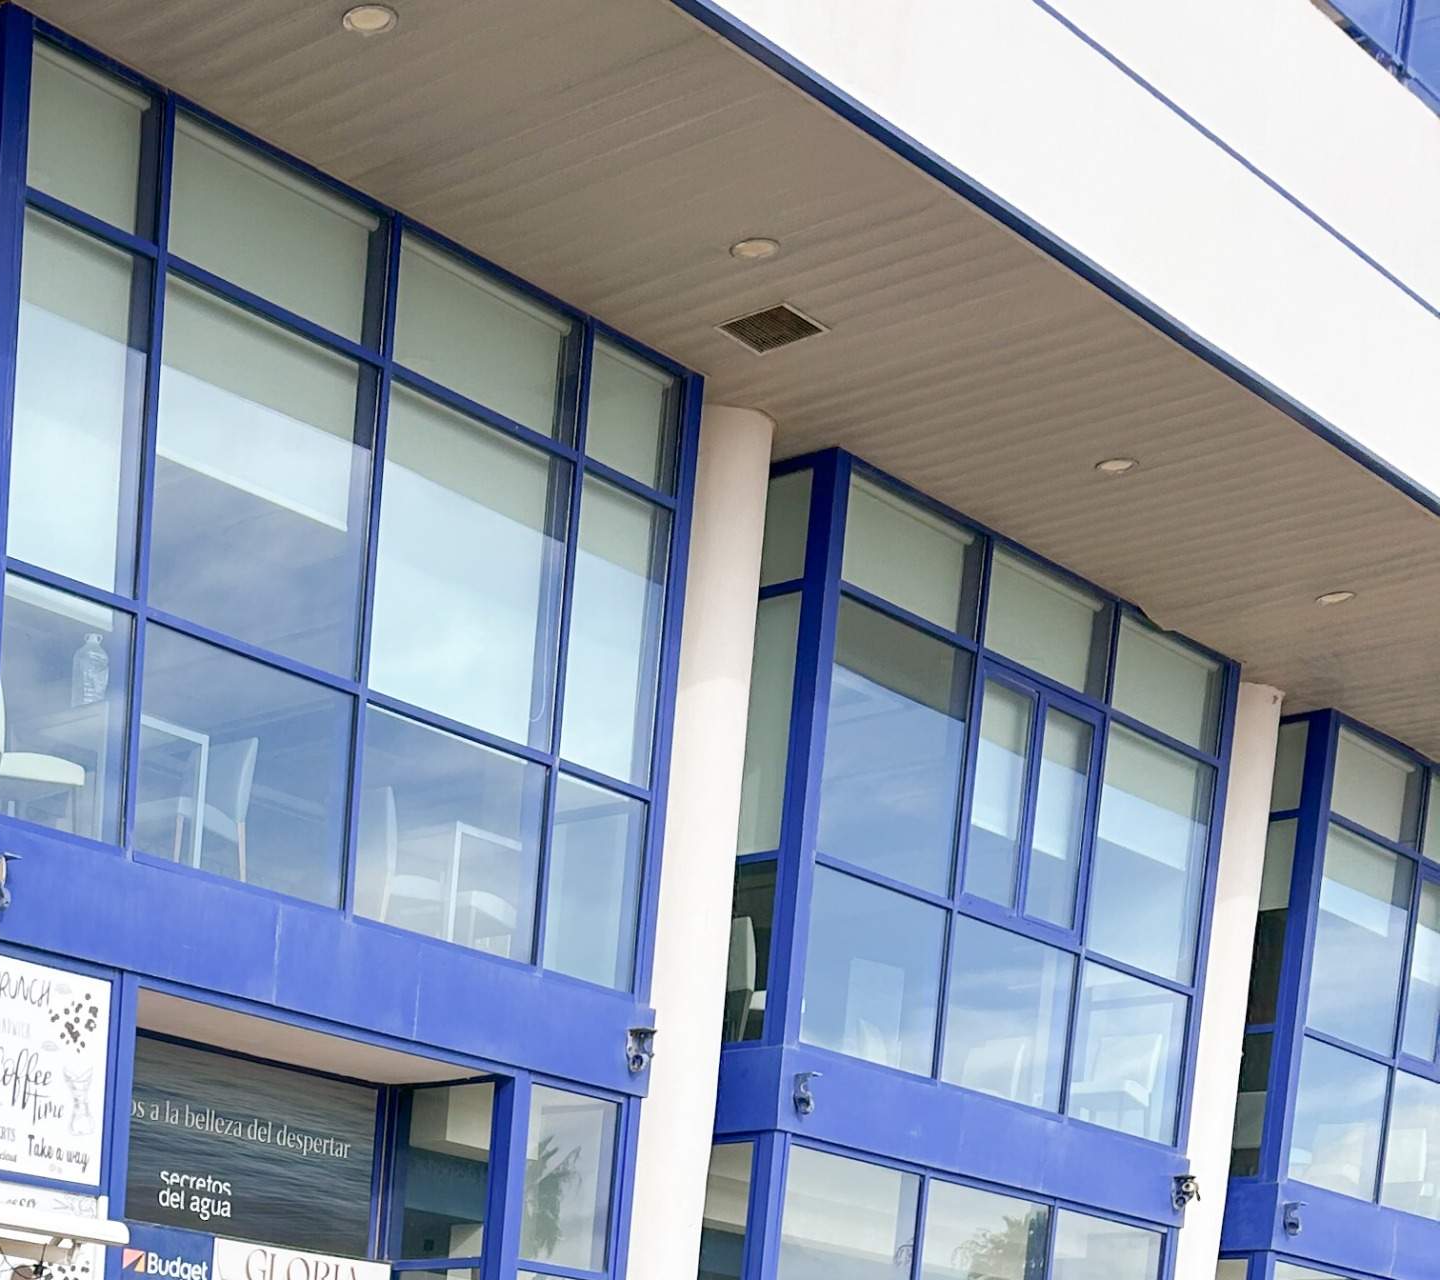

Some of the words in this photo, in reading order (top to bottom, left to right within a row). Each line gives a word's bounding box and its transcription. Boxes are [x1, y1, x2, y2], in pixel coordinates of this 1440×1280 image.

[150, 1104, 159, 1120] a
[165, 1100, 179, 1124] la
[185, 1104, 242, 1137] belleza
[247, 1118, 272, 1143] del
[276, 1124, 351, 1159] despertar
[28, 1134, 53, 1159] Take
[56, 1146, 63, 1161] a
[66, 1149, 89, 1173] way
[160, 1170, 232, 1196] secretos
[158, 1187, 185, 1210] del
[190, 1195, 231, 1221] agua
